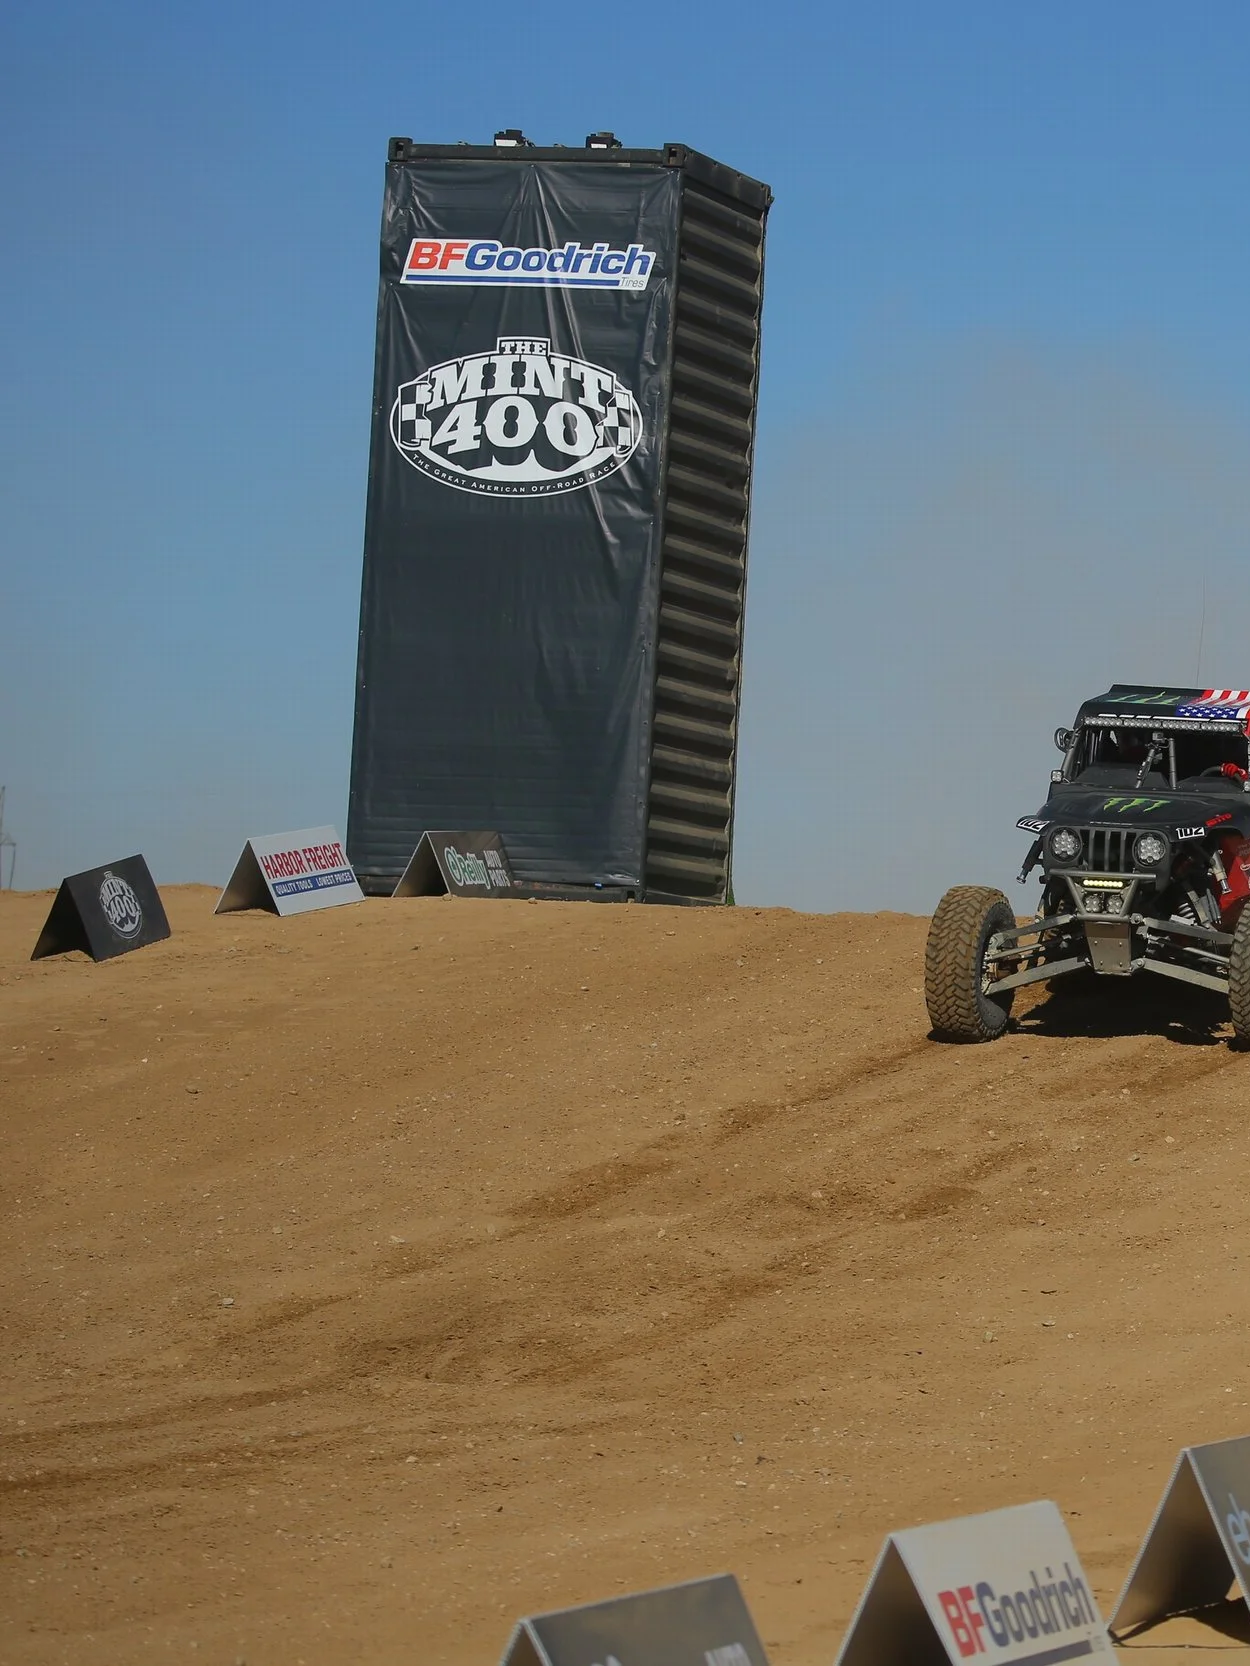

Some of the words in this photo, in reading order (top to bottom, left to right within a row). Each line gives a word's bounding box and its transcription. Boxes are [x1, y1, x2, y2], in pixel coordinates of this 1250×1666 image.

[407, 241, 651, 275] BFGoodrich
[619, 277, 645, 288] Tires
[501, 341, 547, 354] THE
[424, 354, 614, 414] MINT
[431, 396, 600, 456] 400
[412, 454, 430, 470] THE
[434, 469, 466, 485] GREAT
[471, 481, 526, 493] AMERICAN
[589, 462, 616, 479] RACE
[1178, 827, 1203, 837] 102
[260, 850, 308, 880] HARBOR
[302, 842, 346, 872] FREIGHT
[275, 883, 297, 895] QUALITY
[296, 879, 313, 891] TOOLS
[315, 874, 335, 886] LOWEST
[334, 872, 353, 883] PRICES
[110, 895, 136, 923] 400
[937, 1561, 1096, 1658] BFGoodrich
